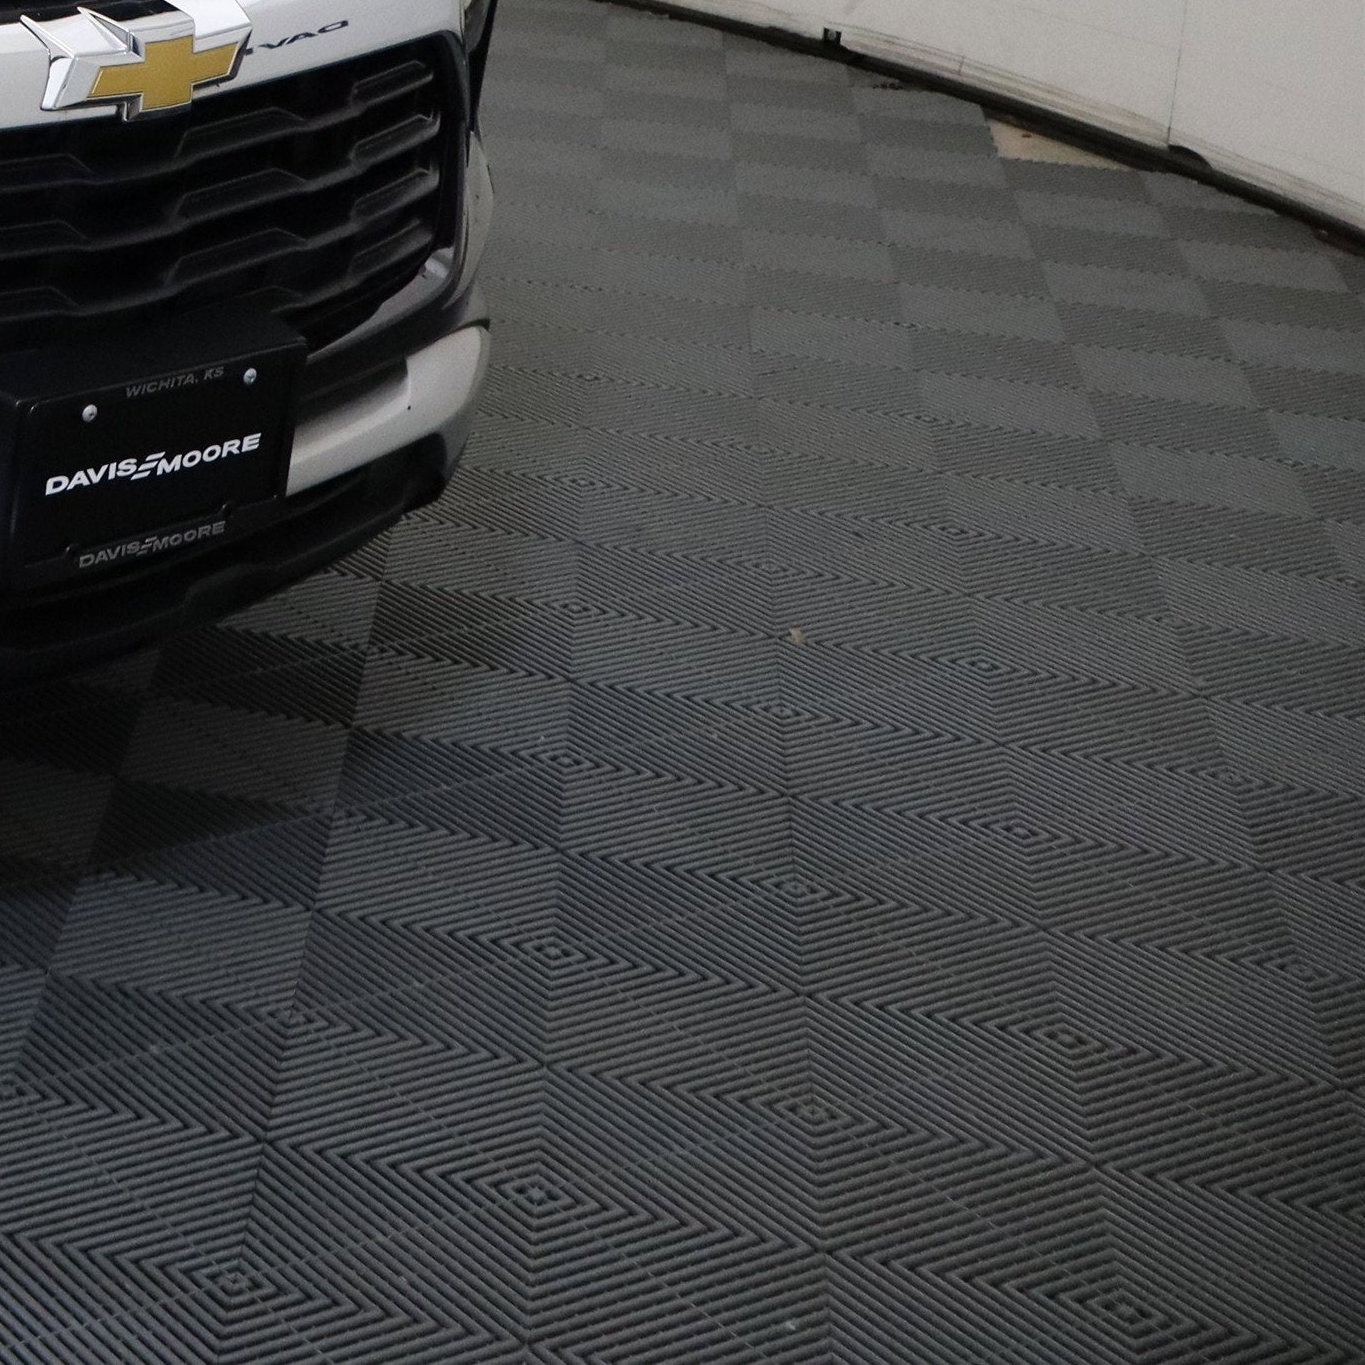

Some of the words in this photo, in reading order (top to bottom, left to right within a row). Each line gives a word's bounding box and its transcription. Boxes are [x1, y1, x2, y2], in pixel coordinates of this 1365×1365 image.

[203, 366, 224, 381] KS
[45, 457, 137, 496] DAVIS
[155, 432, 262, 476] MOORE
[78, 540, 141, 569] DAVIS
[152, 520, 226, 553] MOORE
